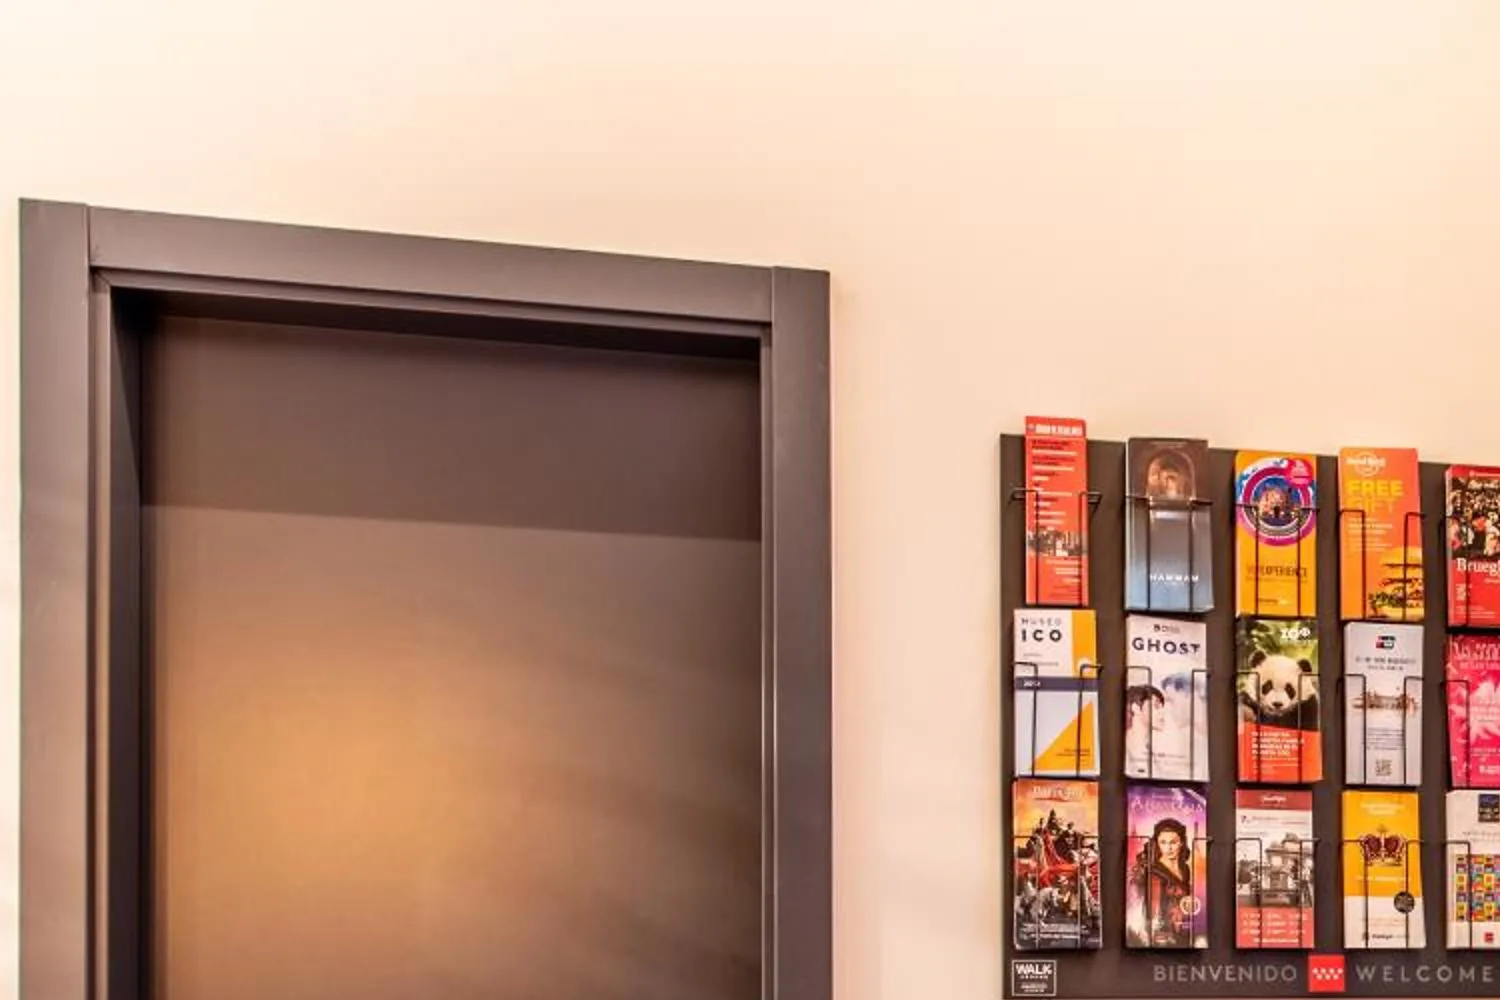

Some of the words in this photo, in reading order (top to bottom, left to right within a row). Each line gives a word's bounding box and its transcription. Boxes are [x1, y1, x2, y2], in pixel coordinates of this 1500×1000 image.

[1347, 479, 1404, 497] FREE
[1021, 629, 1063, 642] ICO
[1131, 636, 1201, 655] GHOST
[1015, 963, 1053, 975] WALK
[1153, 964, 1298, 983] BIENVENIDO
[1355, 965, 1496, 983] WELCOME
